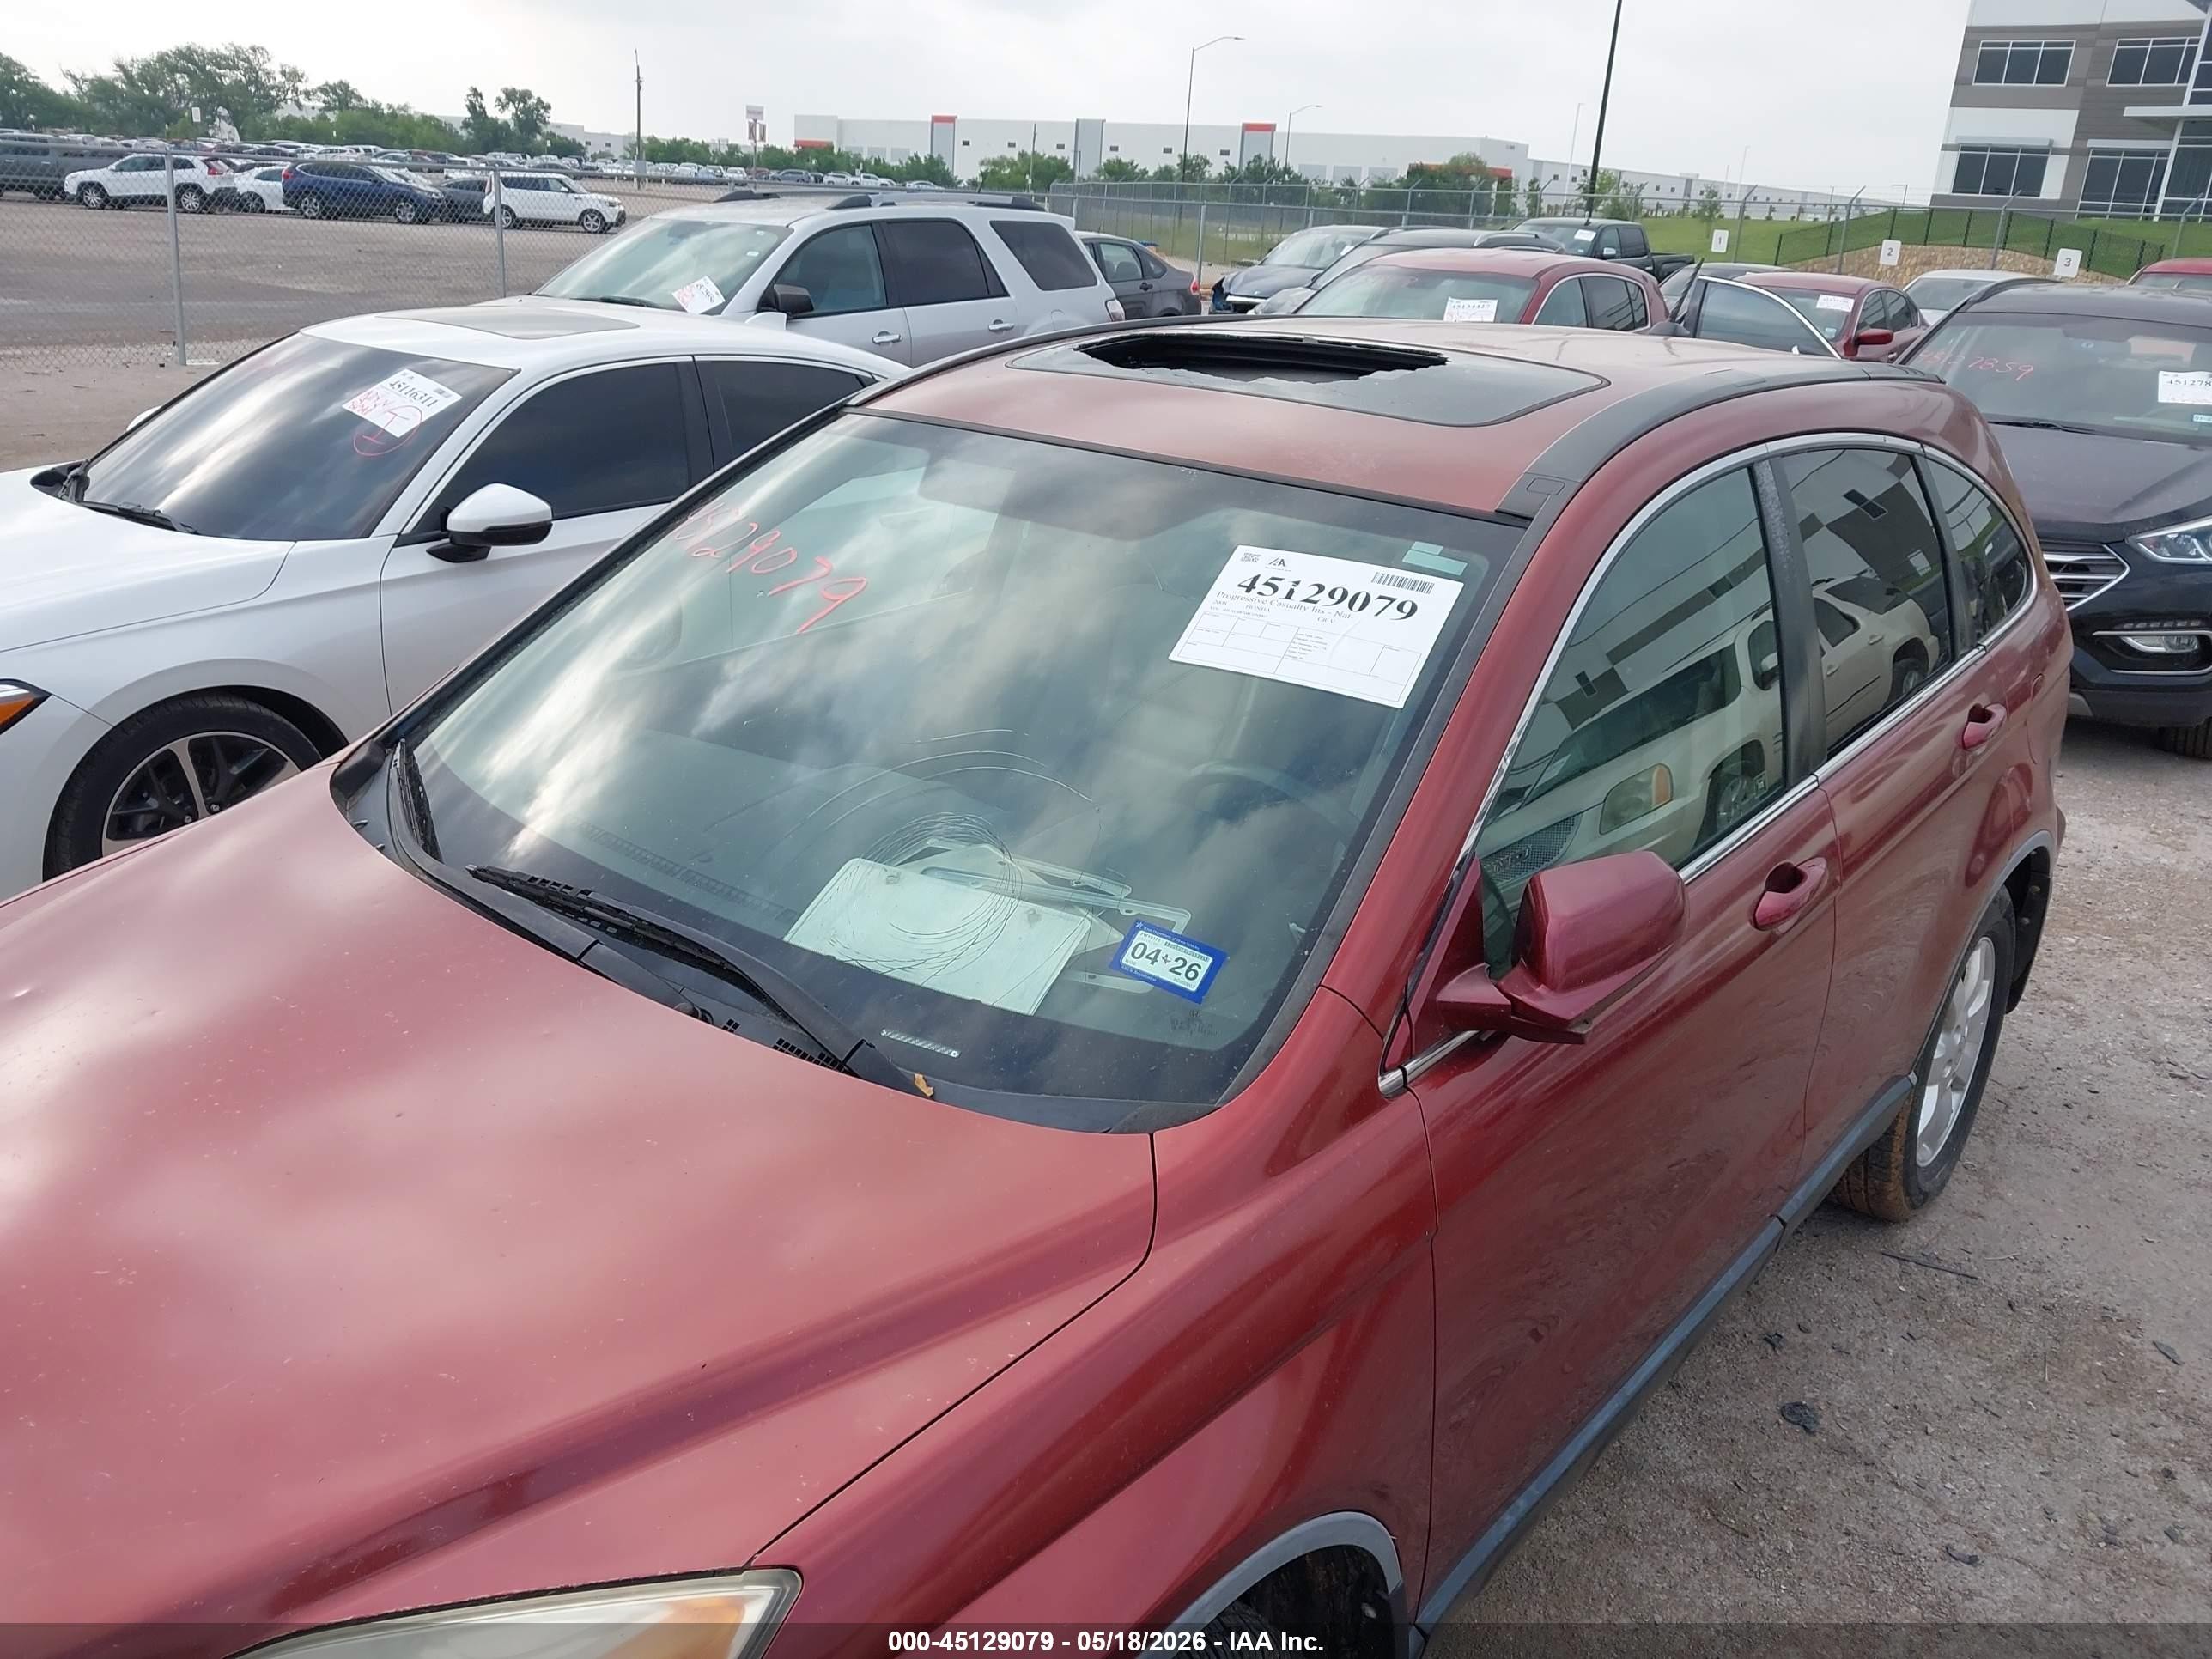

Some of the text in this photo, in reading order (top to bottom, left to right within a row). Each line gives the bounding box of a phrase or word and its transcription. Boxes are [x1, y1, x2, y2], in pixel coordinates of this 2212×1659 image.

[1887, 247, 1893, 257] 2
[2063, 257, 2072, 267] 3
[1216, 591, 1269, 605] Progressive
[1269, 599, 1310, 612] Casualty
[1311, 605, 1325, 613] Ins
[1334, 611, 1352, 619] Nat
[1236, 574, 1419, 621] 45129079
[1131, 942, 1202, 981] 04 26
